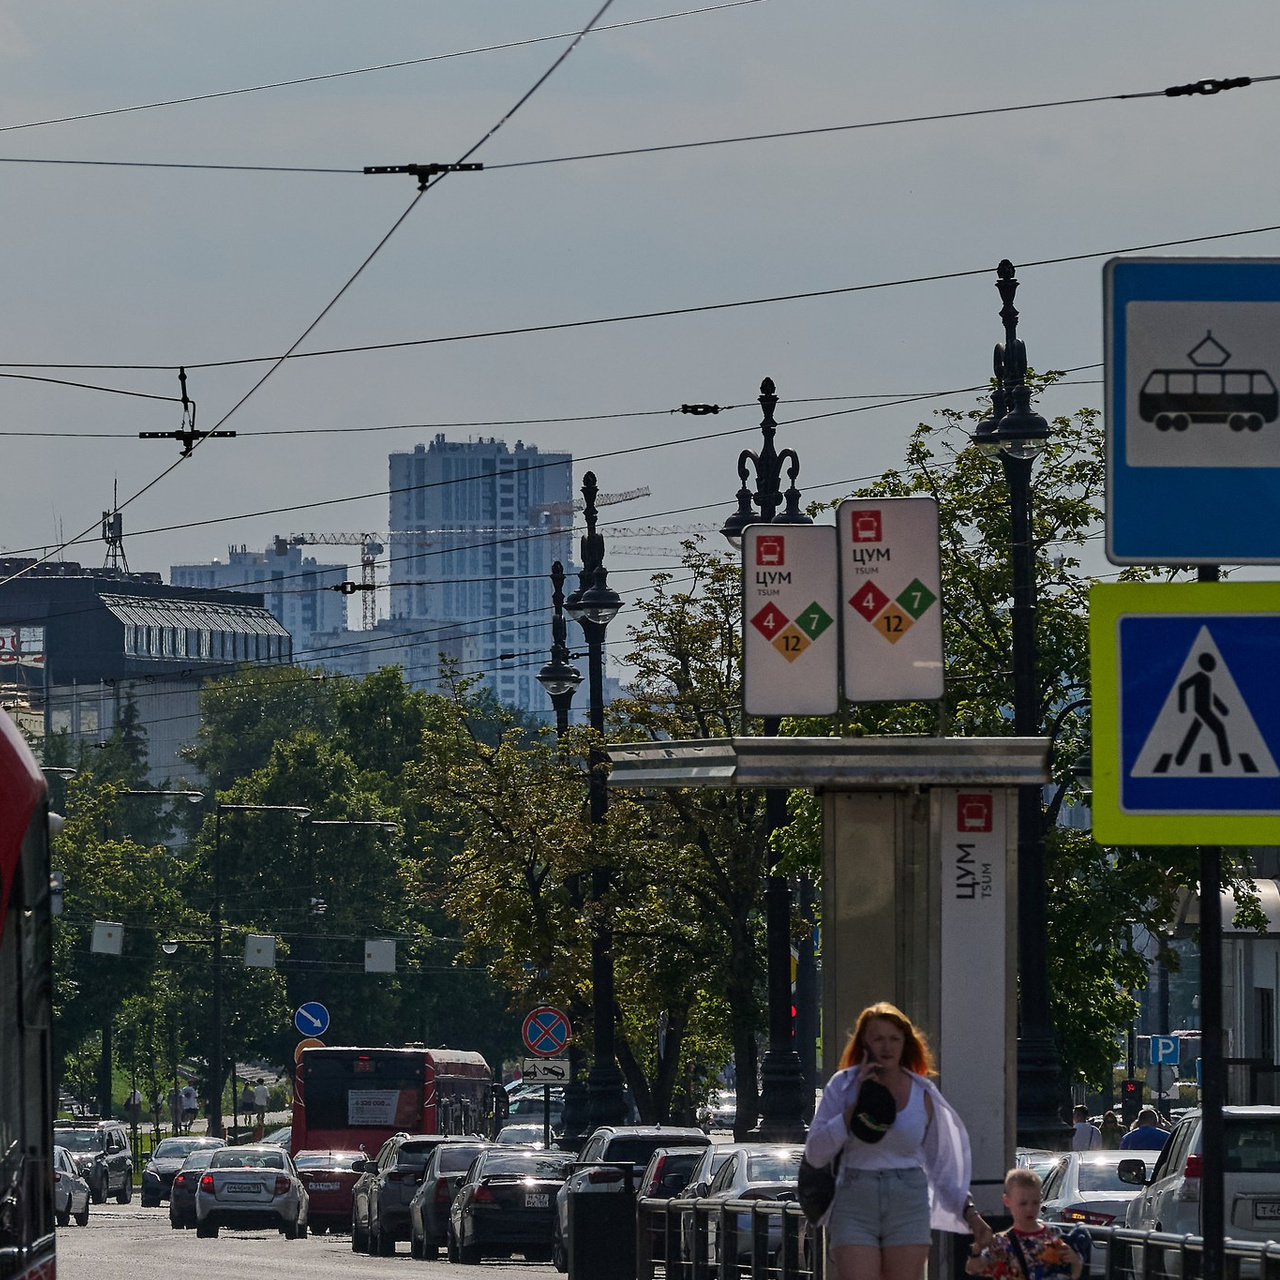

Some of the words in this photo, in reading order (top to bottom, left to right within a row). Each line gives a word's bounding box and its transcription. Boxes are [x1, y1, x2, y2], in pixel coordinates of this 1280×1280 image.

[853, 548, 891, 565] ЦУМ
[756, 572, 792, 587] ЦУМ
[862, 592, 875, 610] 4
[911, 592, 922, 609] 7
[763, 613, 775, 629] 4
[809, 614, 820, 630] 7
[884, 616, 903, 632] 12
[782, 635, 801, 651] 12
[956, 843, 980, 899] ЦУМ
[981, 863, 992, 899] TSUM
[1158, 1038, 1175, 1062] P
